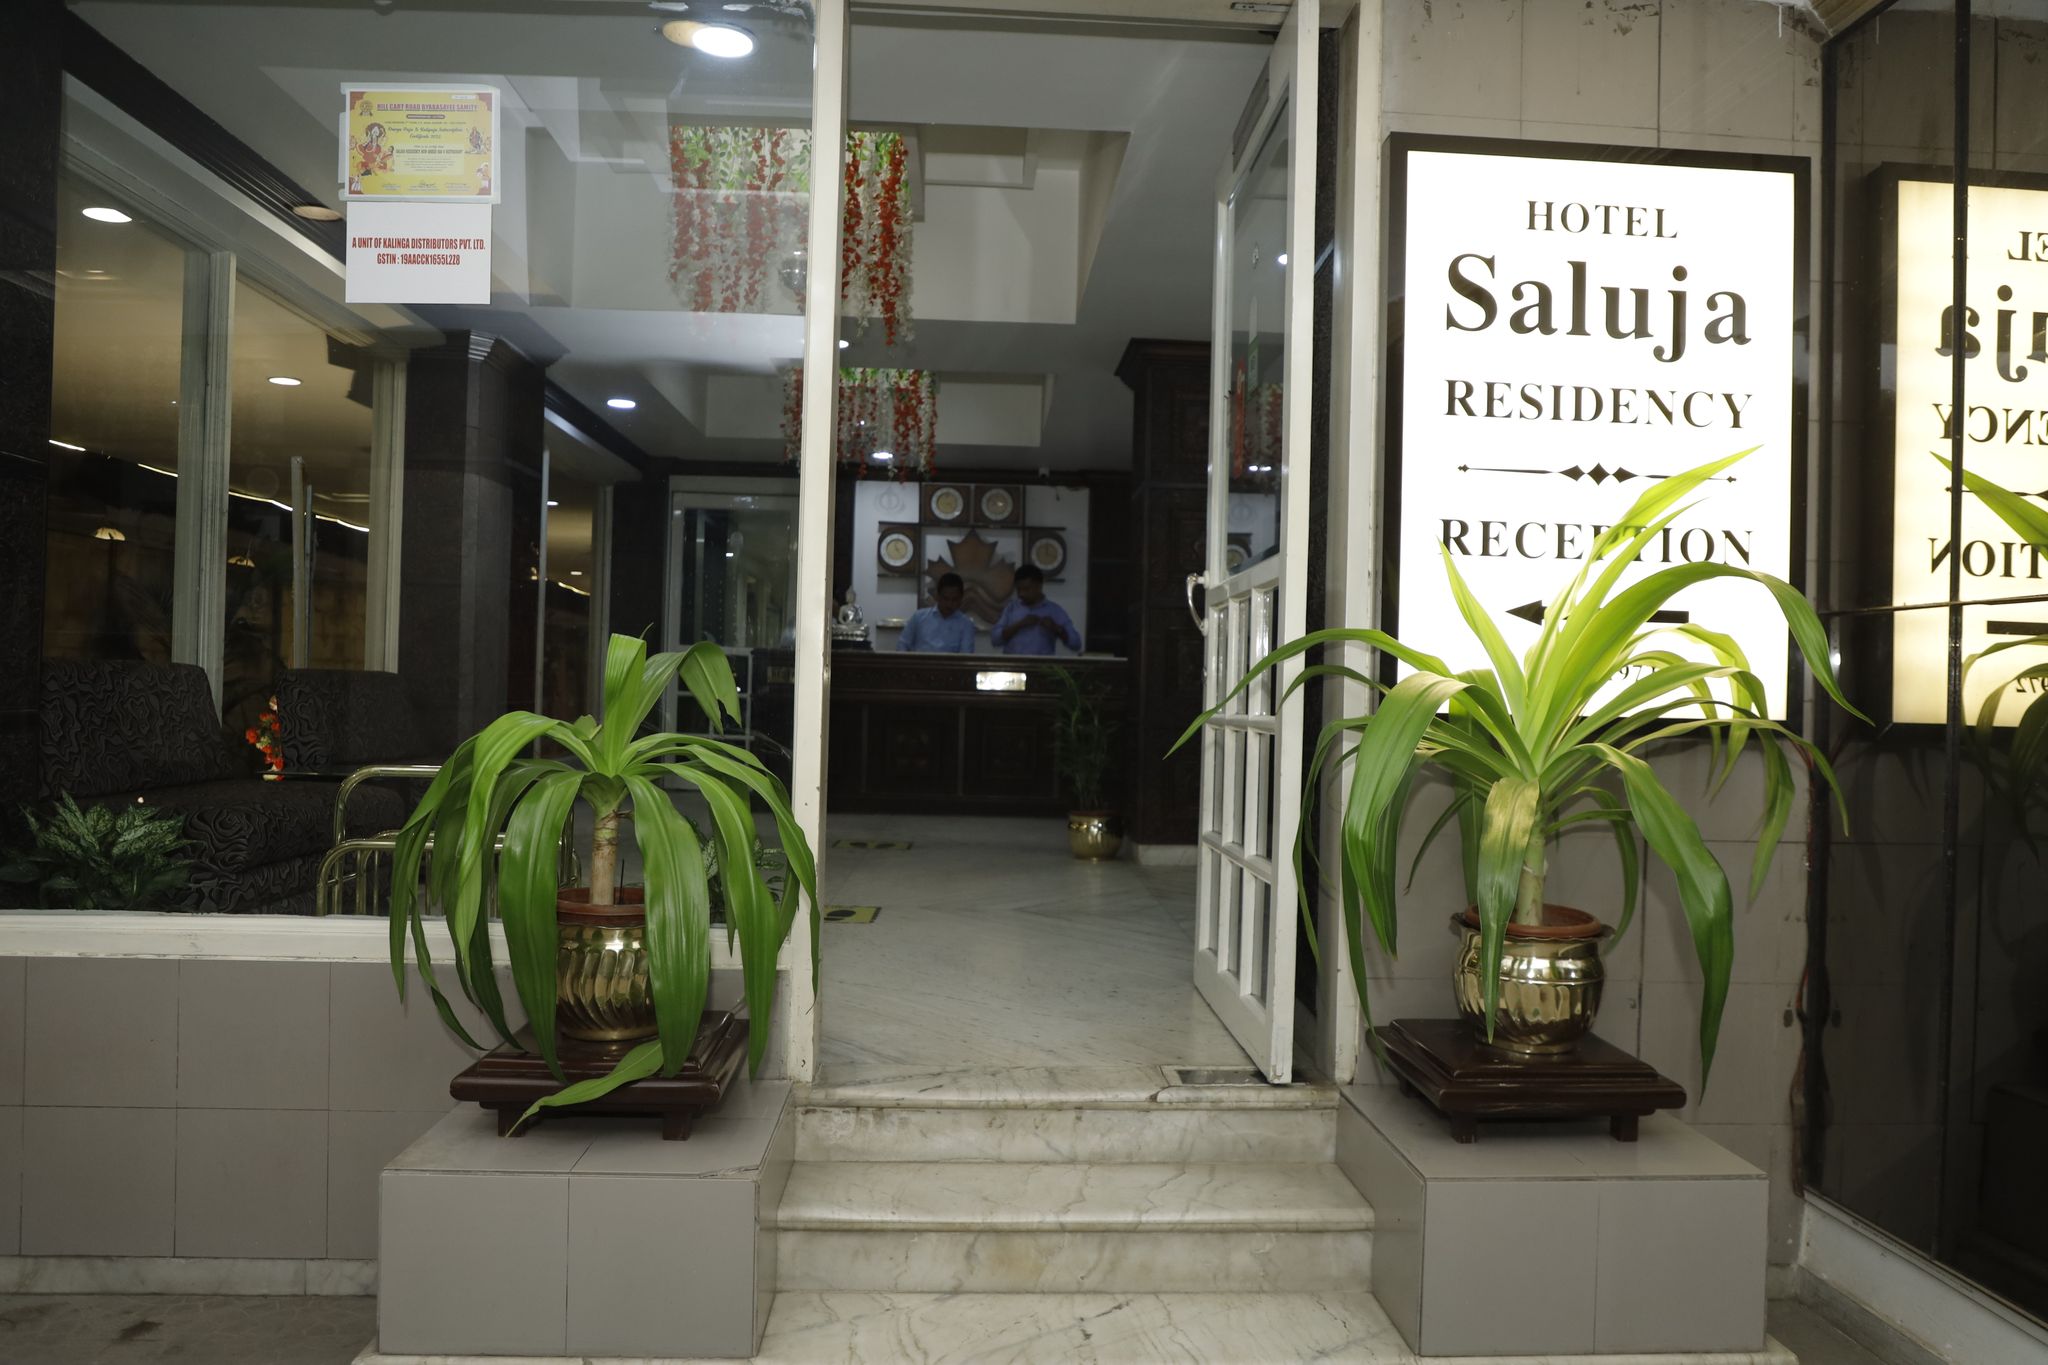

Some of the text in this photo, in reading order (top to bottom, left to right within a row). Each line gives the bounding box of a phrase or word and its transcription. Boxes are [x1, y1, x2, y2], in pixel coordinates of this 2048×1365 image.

[1528, 200, 1677, 239] HOTEL
[352, 237, 486, 250] A UNIT OF KALINGA DISTRIBUTORS PVT. LTD.
[377, 253, 396, 265] GSTIN
[1446, 253, 1752, 363] Saluja
[1445, 379, 1753, 429] RESIDENCY
